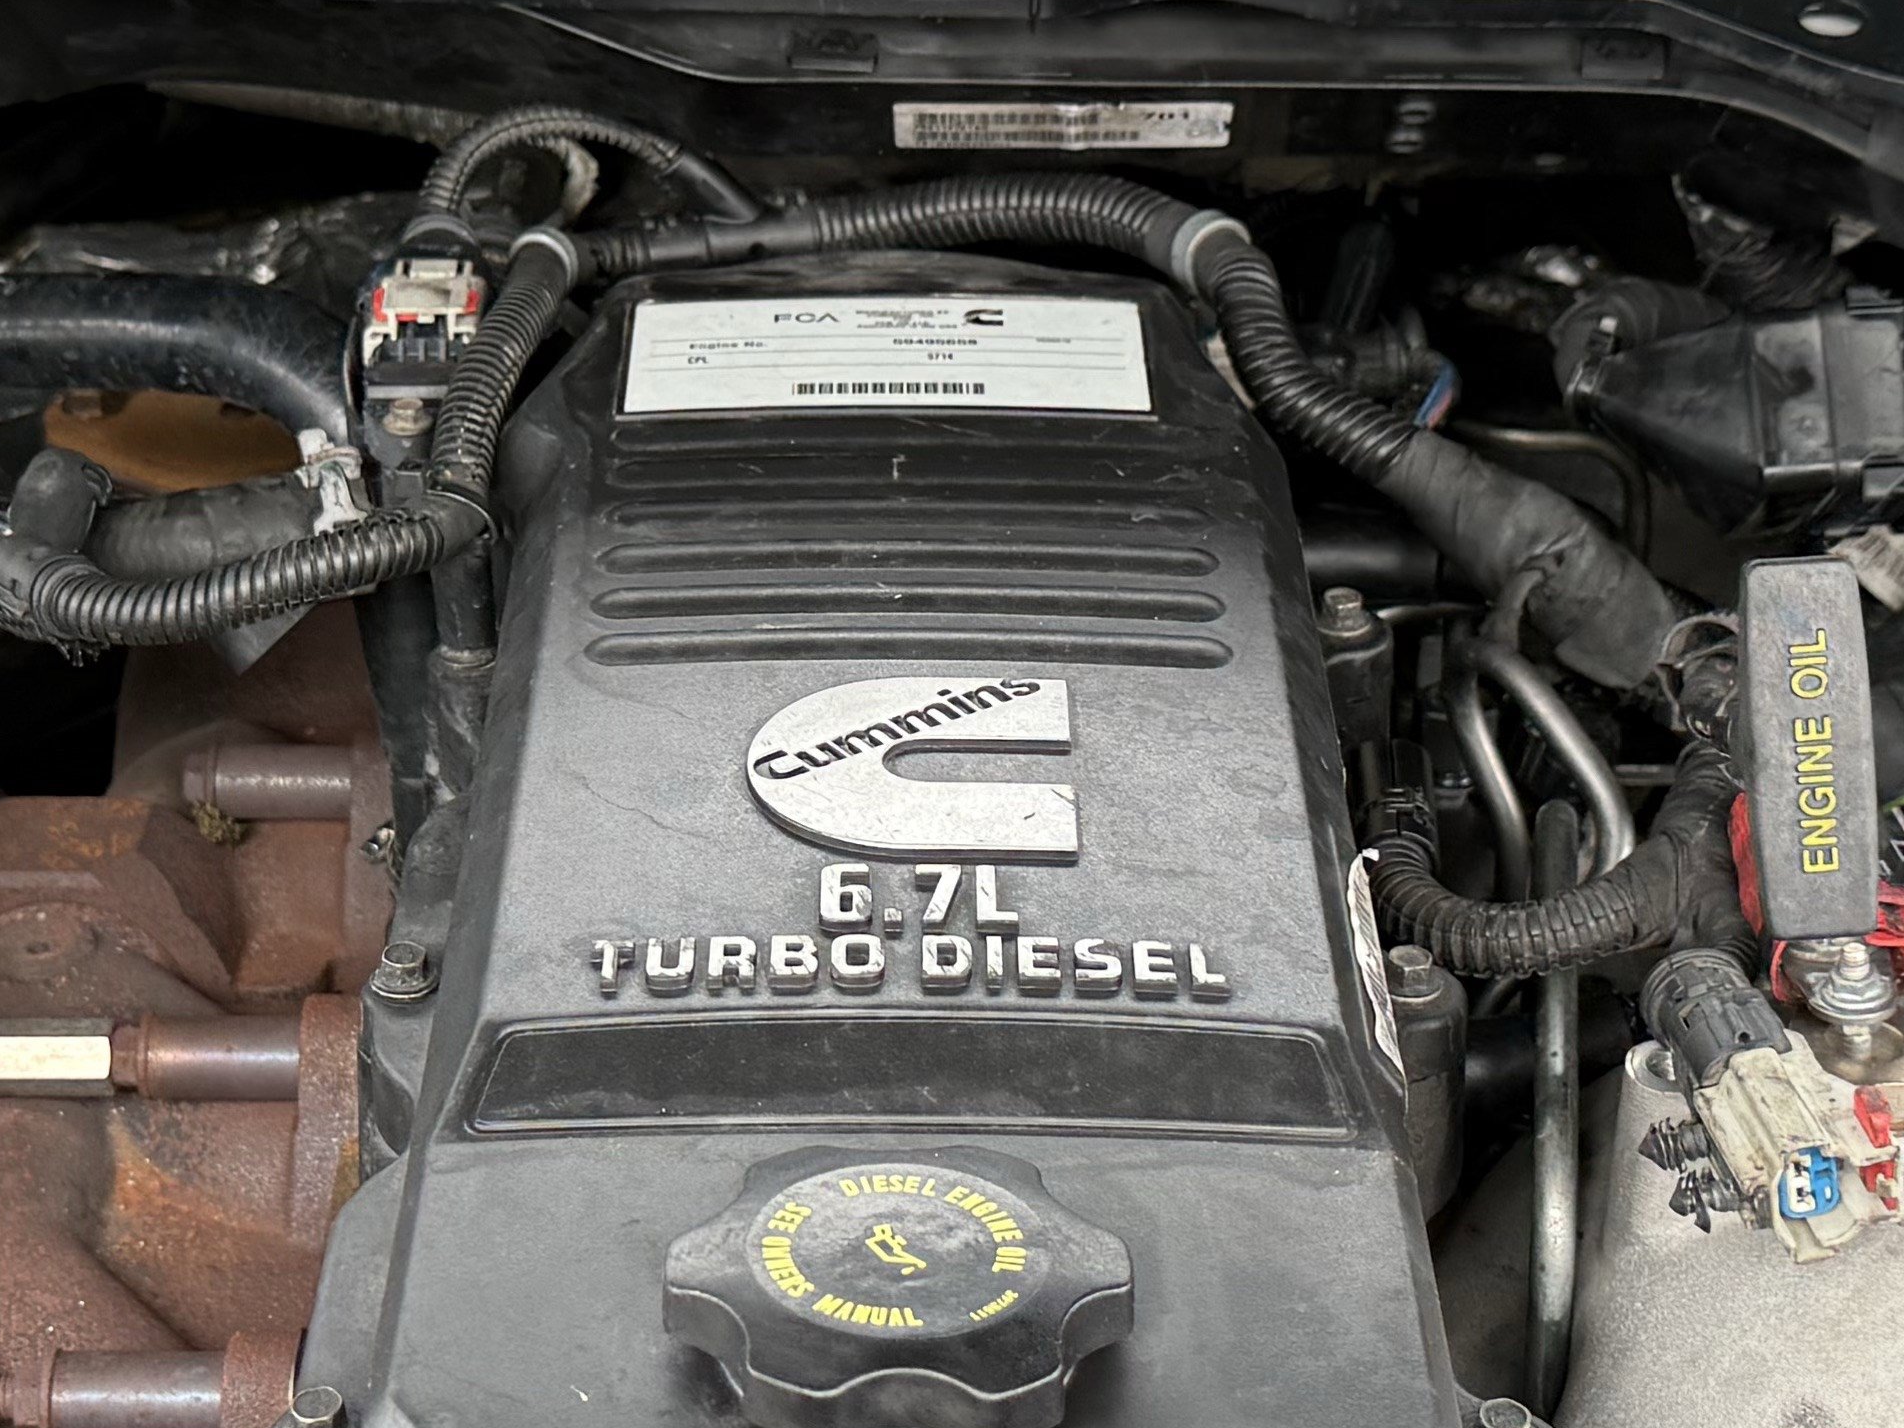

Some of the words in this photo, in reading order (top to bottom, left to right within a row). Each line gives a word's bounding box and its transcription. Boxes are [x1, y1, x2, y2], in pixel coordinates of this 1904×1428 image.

[774, 312, 840, 324] FCA
[1788, 627, 1830, 700] OIL
[752, 676, 1043, 781] Cummins
[1792, 713, 1841, 874] ENGINE
[818, 862, 1020, 933] 6.7L
[590, 934, 886, 998] TURBO
[920, 934, 1233, 1001] DIESEL
[767, 1201, 813, 1235] SEE
[811, 1293, 924, 1327] MANUAL
[839, 1174, 937, 1198] DIESEL
[944, 1185, 1025, 1245] ENGINE
[992, 1245, 1027, 1273] OIL
